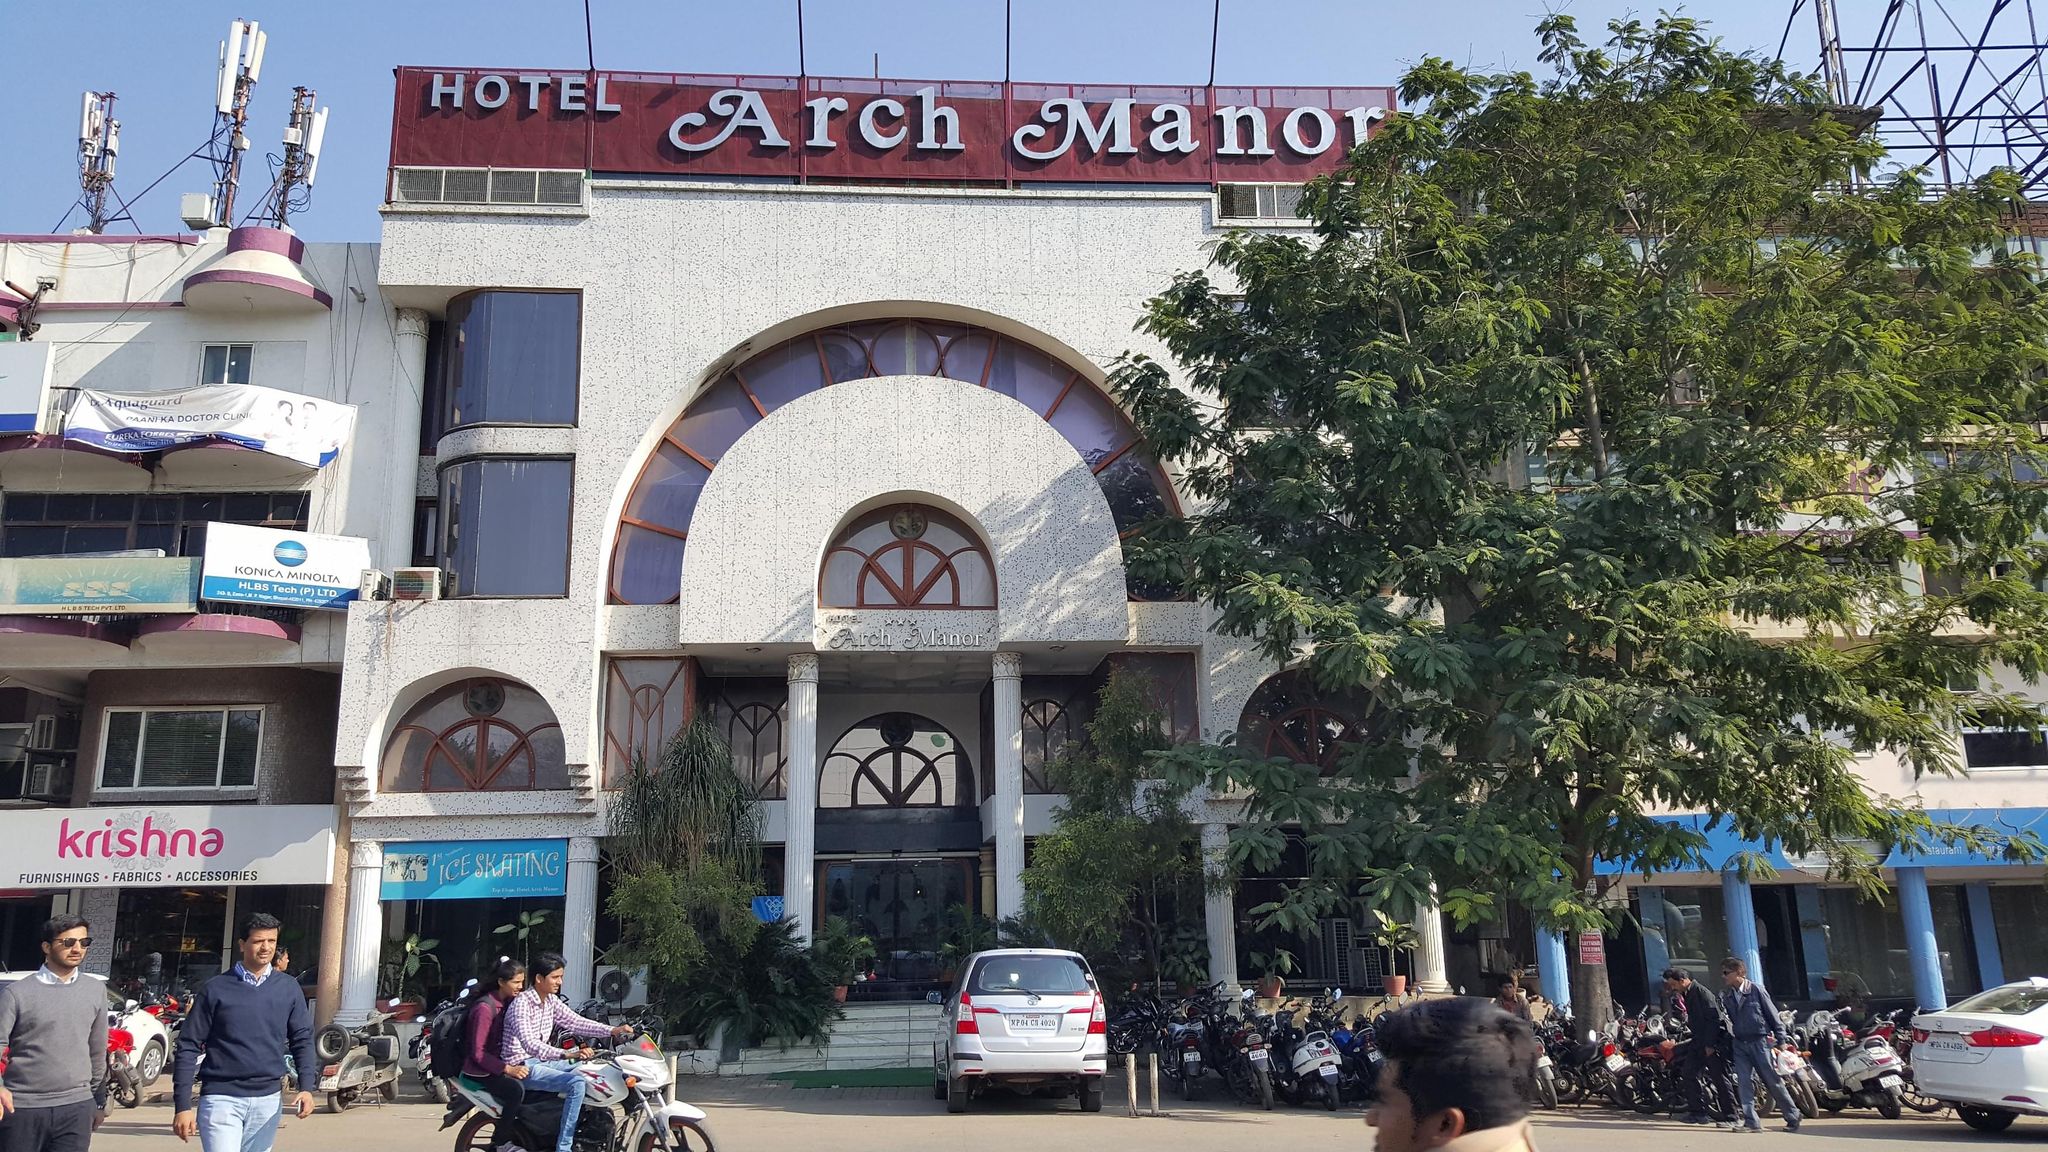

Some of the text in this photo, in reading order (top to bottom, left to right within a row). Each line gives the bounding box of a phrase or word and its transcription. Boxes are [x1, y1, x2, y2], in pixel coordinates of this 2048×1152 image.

[430, 73, 1385, 161] HOTEL Arch Manor
[102, 394, 184, 411] Aquaguard
[177, 413, 220, 424] DOCTOR
[104, 432, 139, 441] EUREKA
[234, 565, 341, 584] KONICA MINOLTA
[238, 581, 269, 591] HLBS
[272, 584, 298, 594] Tech
[300, 586, 315, 597] (P)
[829, 628, 983, 650] Arch Manor
[57, 815, 225, 859] krishna
[18, 870, 259, 884] FURNISHINGS FABRICS ACCESSORIES
[439, 851, 560, 885] ICE SKATING
